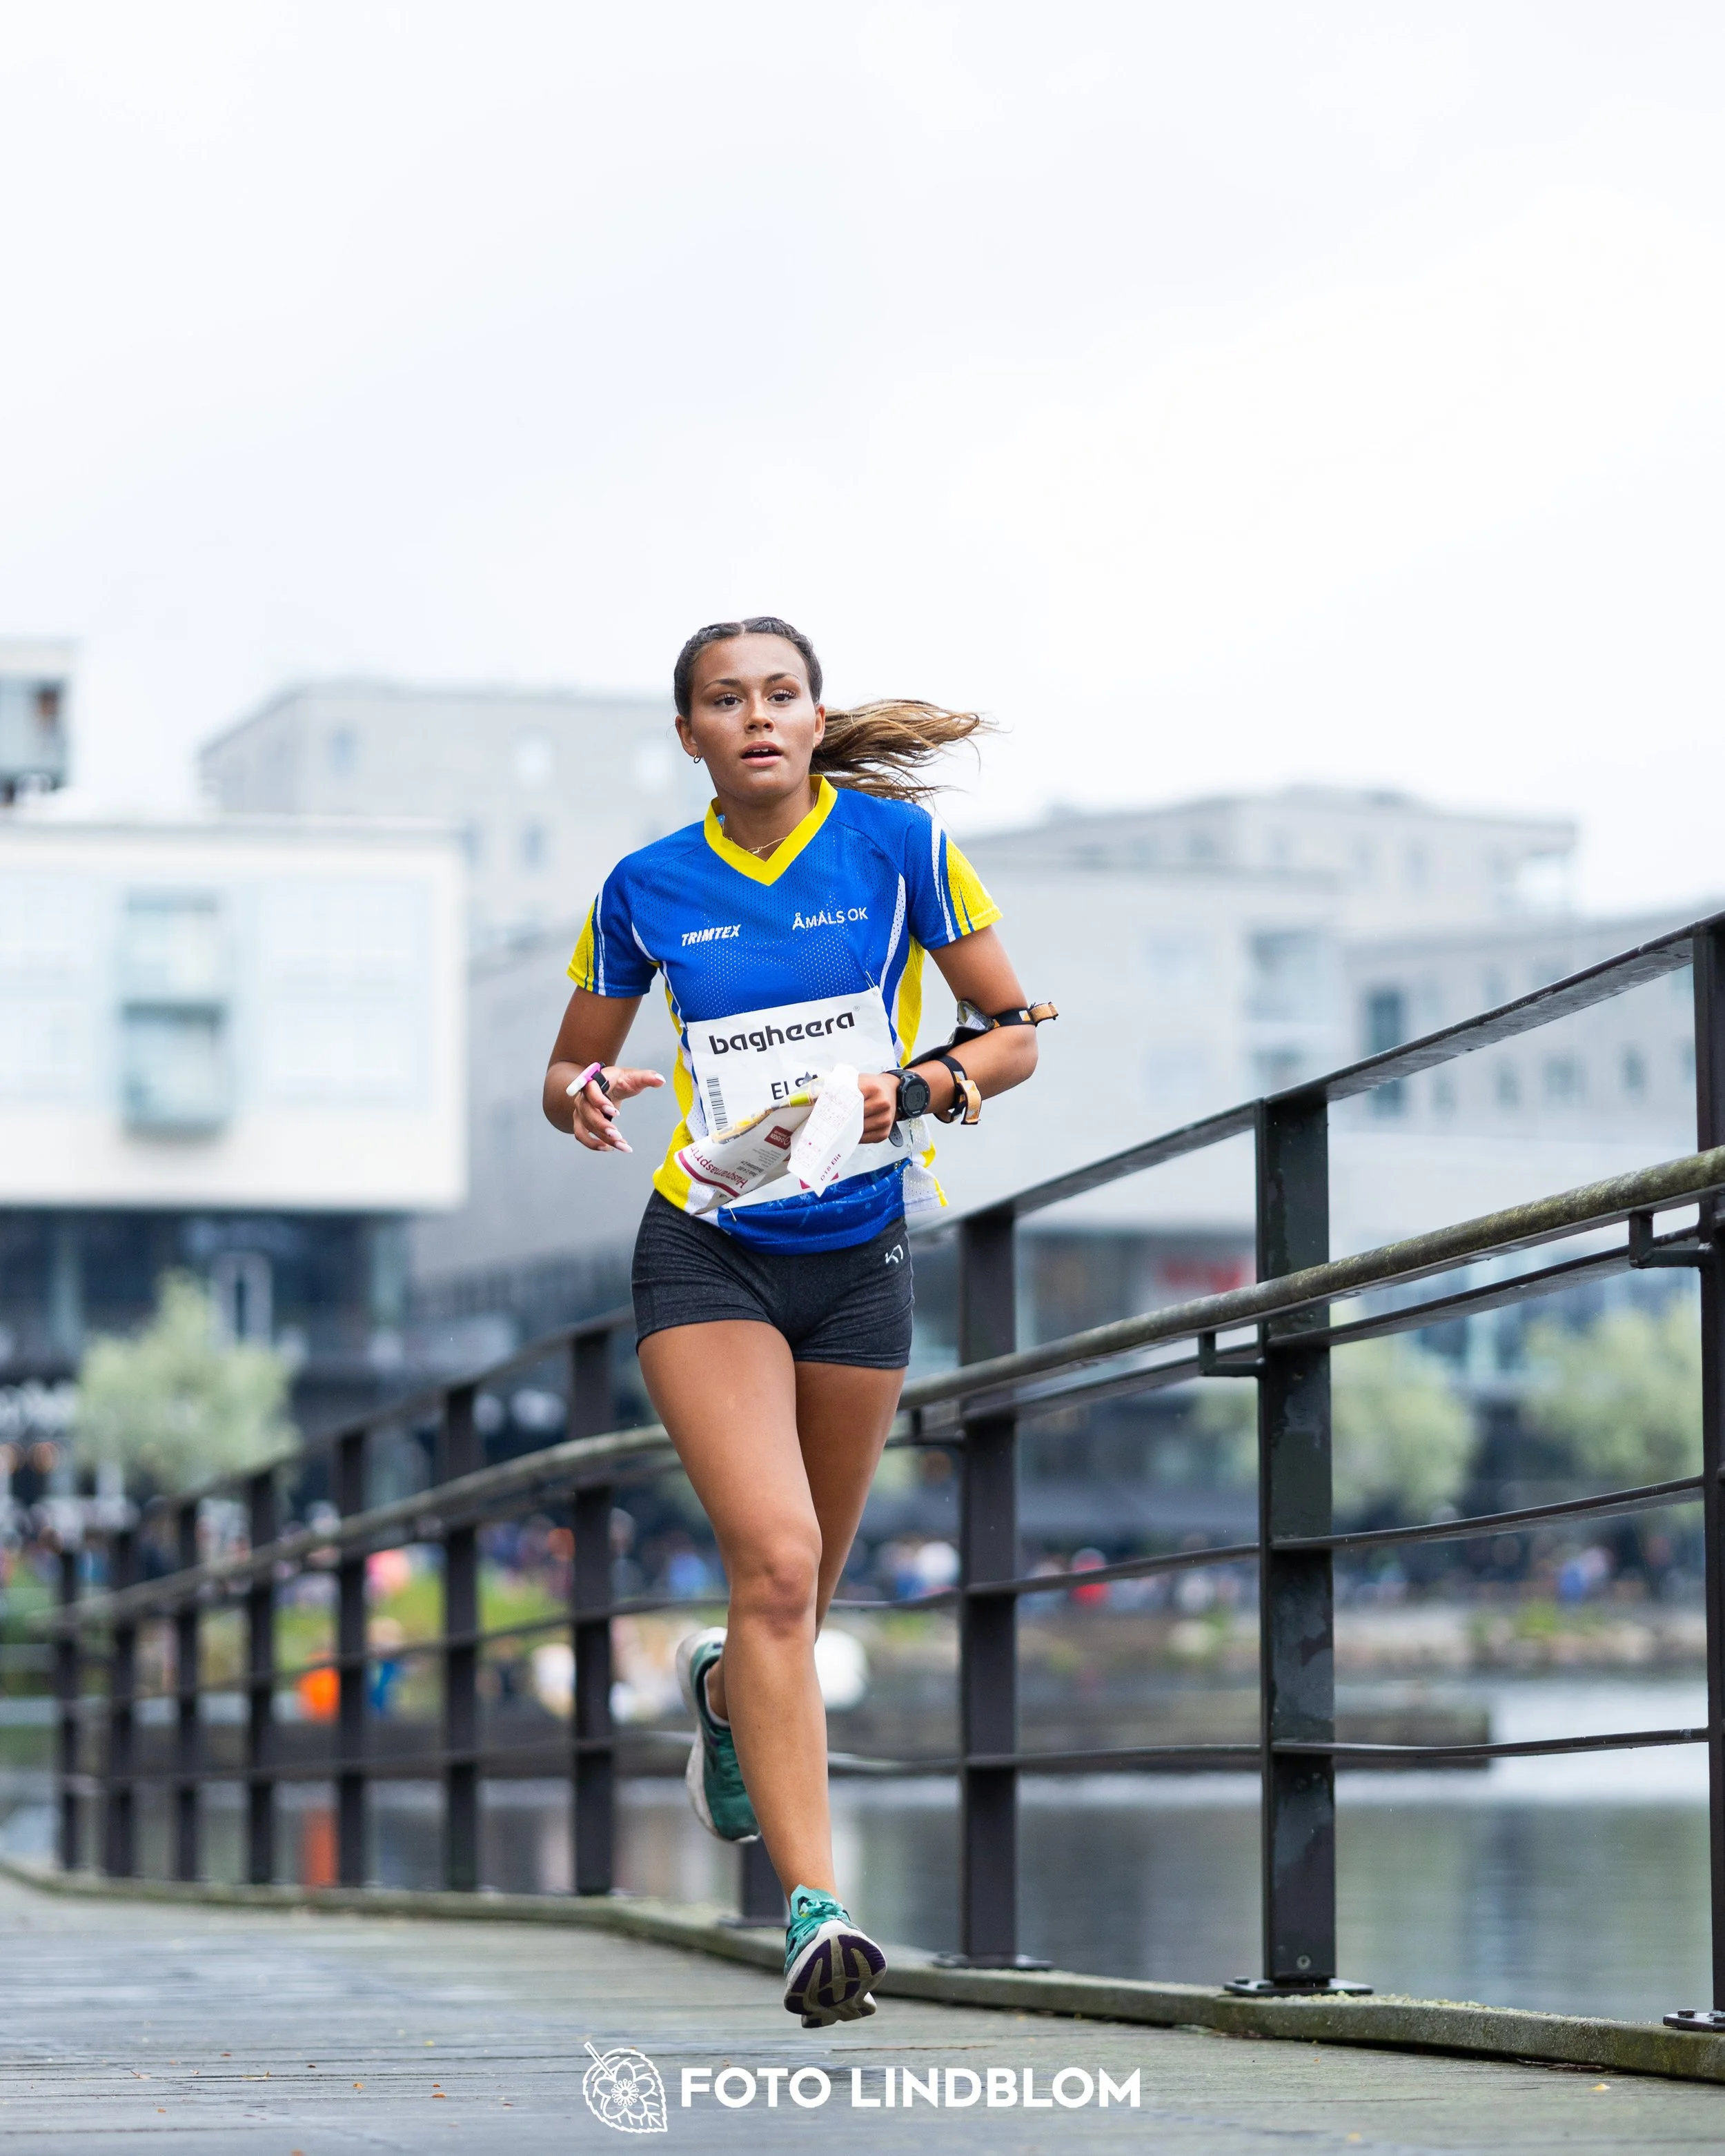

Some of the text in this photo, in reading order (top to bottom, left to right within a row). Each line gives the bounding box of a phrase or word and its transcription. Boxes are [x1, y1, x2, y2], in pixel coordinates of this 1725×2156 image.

[847, 907, 869, 922] OK
[681, 924, 741, 947] TRIMTEX
[708, 1011, 855, 1055] bagheera
